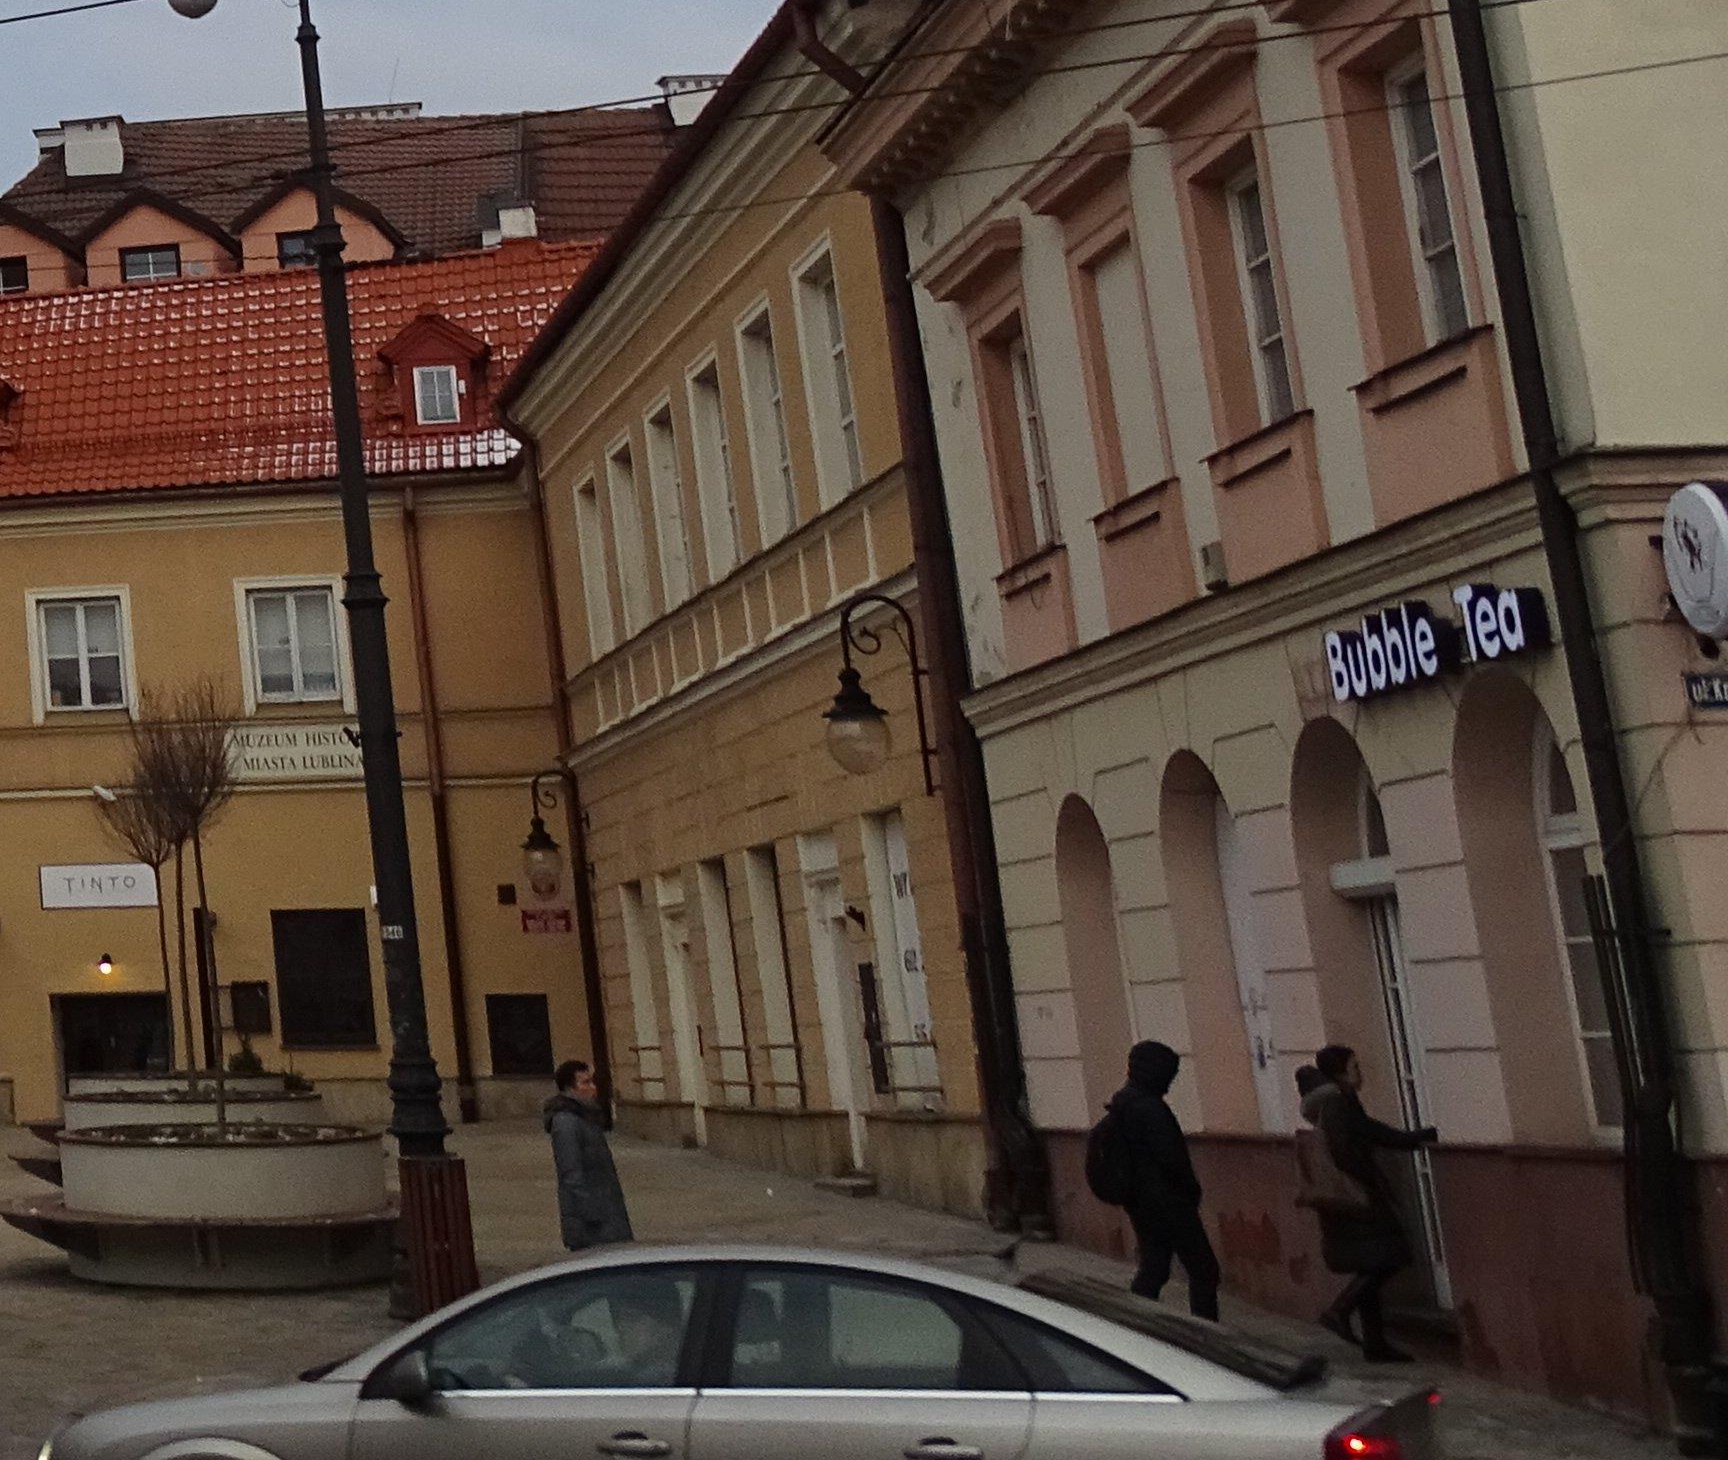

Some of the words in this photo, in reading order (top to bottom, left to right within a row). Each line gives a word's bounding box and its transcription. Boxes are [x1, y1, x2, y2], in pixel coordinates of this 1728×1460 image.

[1325, 603, 1438, 702] Bubble
[1453, 584, 1525, 662] Tea
[232, 732, 297, 749] MUZEUM
[305, 731, 360, 748] HISTO
[244, 756, 297, 771] MIASTA
[63, 874, 137, 895] TINTO
